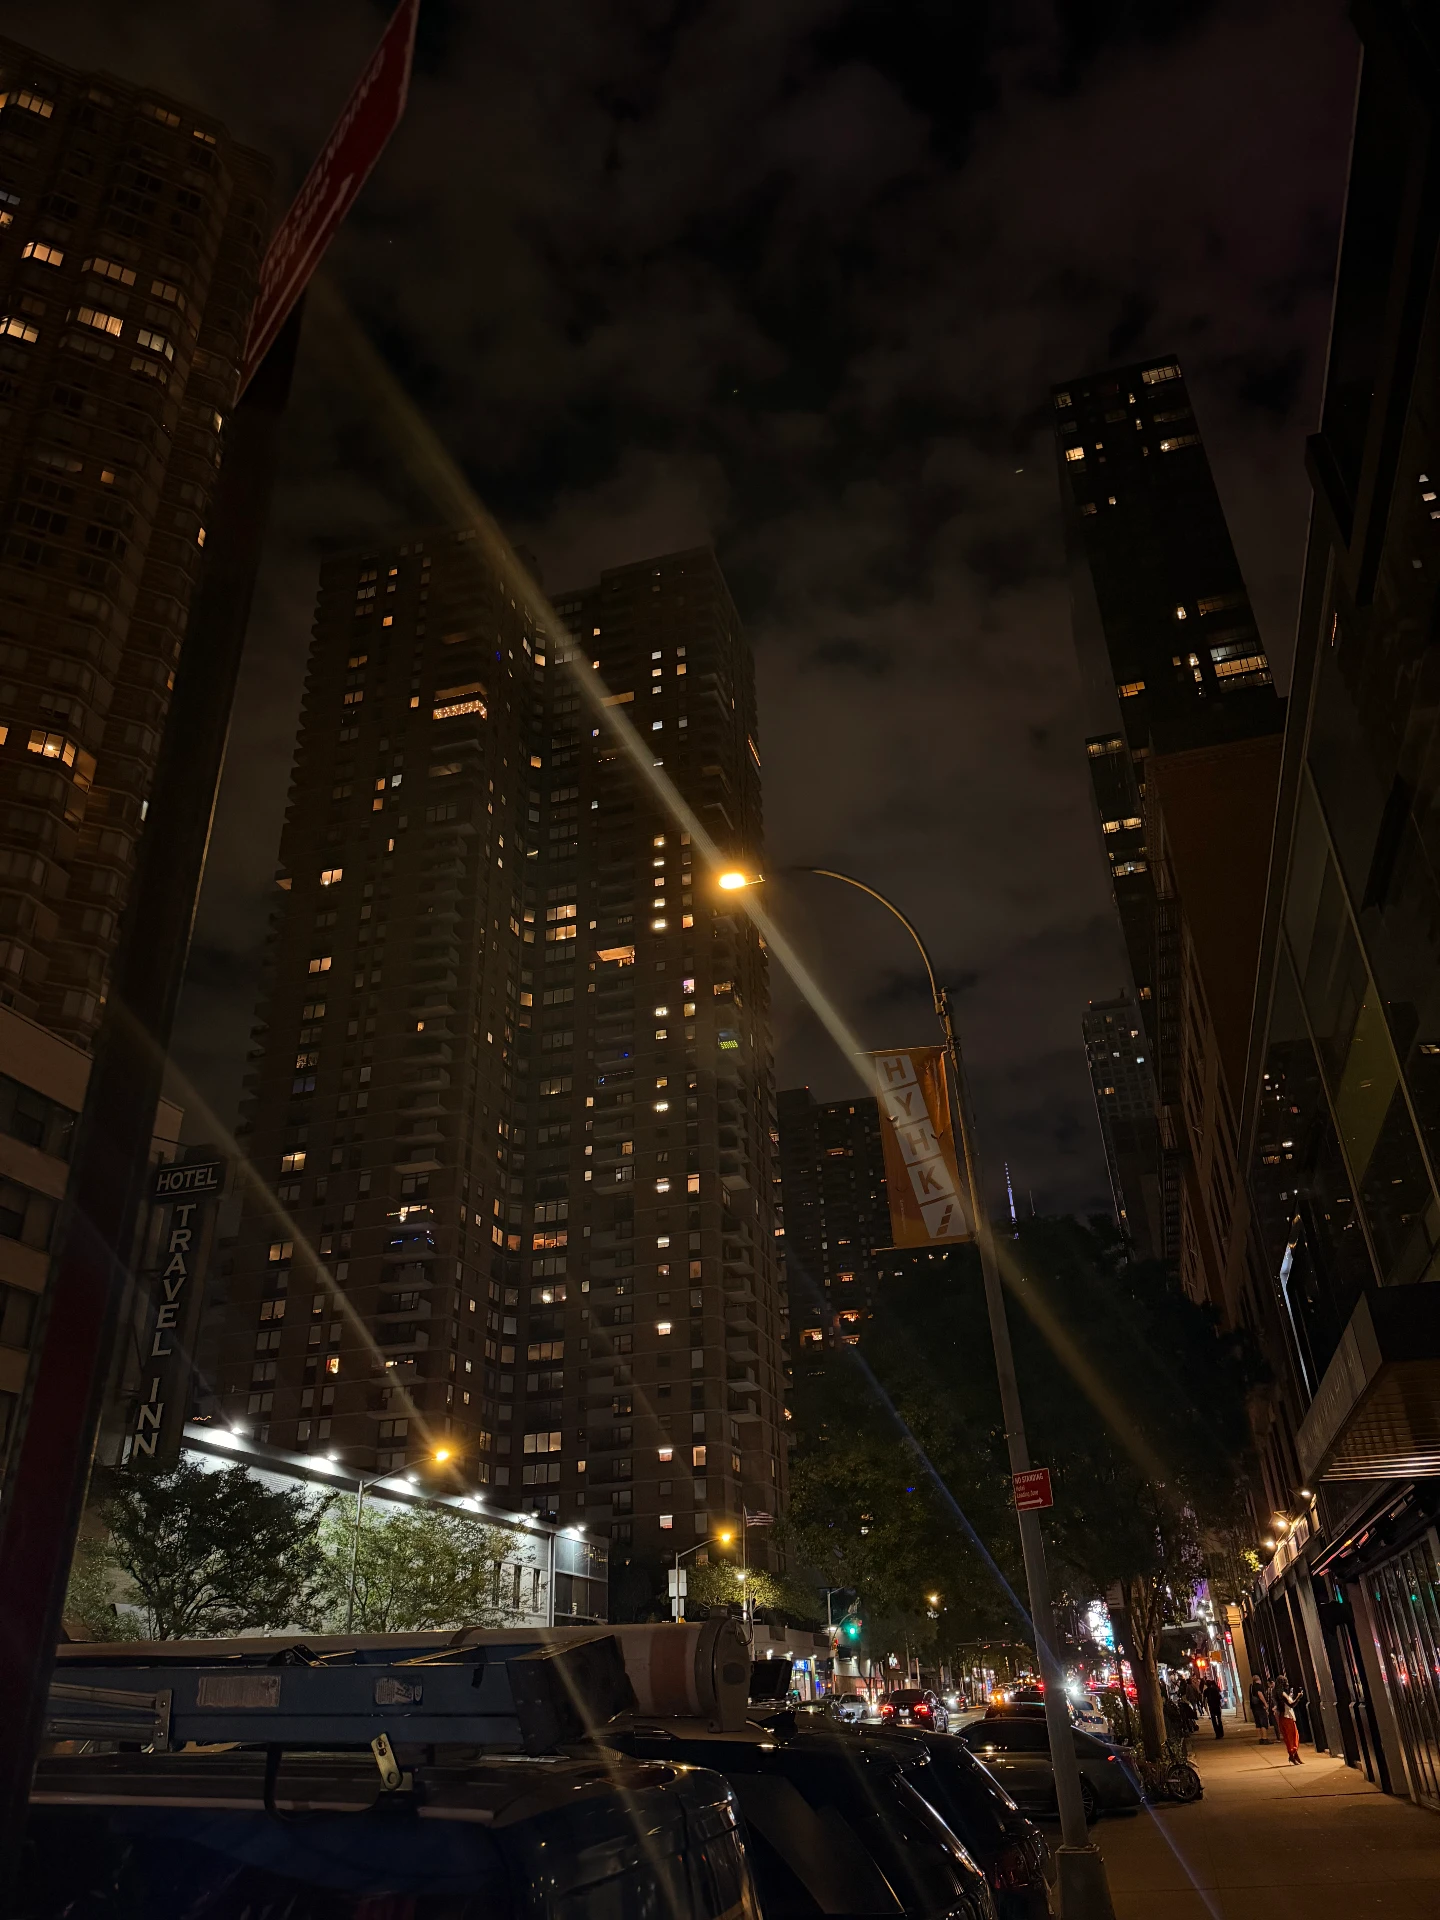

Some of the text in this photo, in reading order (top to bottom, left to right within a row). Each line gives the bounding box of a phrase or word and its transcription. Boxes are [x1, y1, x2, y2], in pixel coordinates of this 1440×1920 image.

[156, 1167, 218, 1192] HOTEL
[132, 1203, 197, 1458] TRAVEL INN
[1022, 1473, 1043, 1483] STANDING
